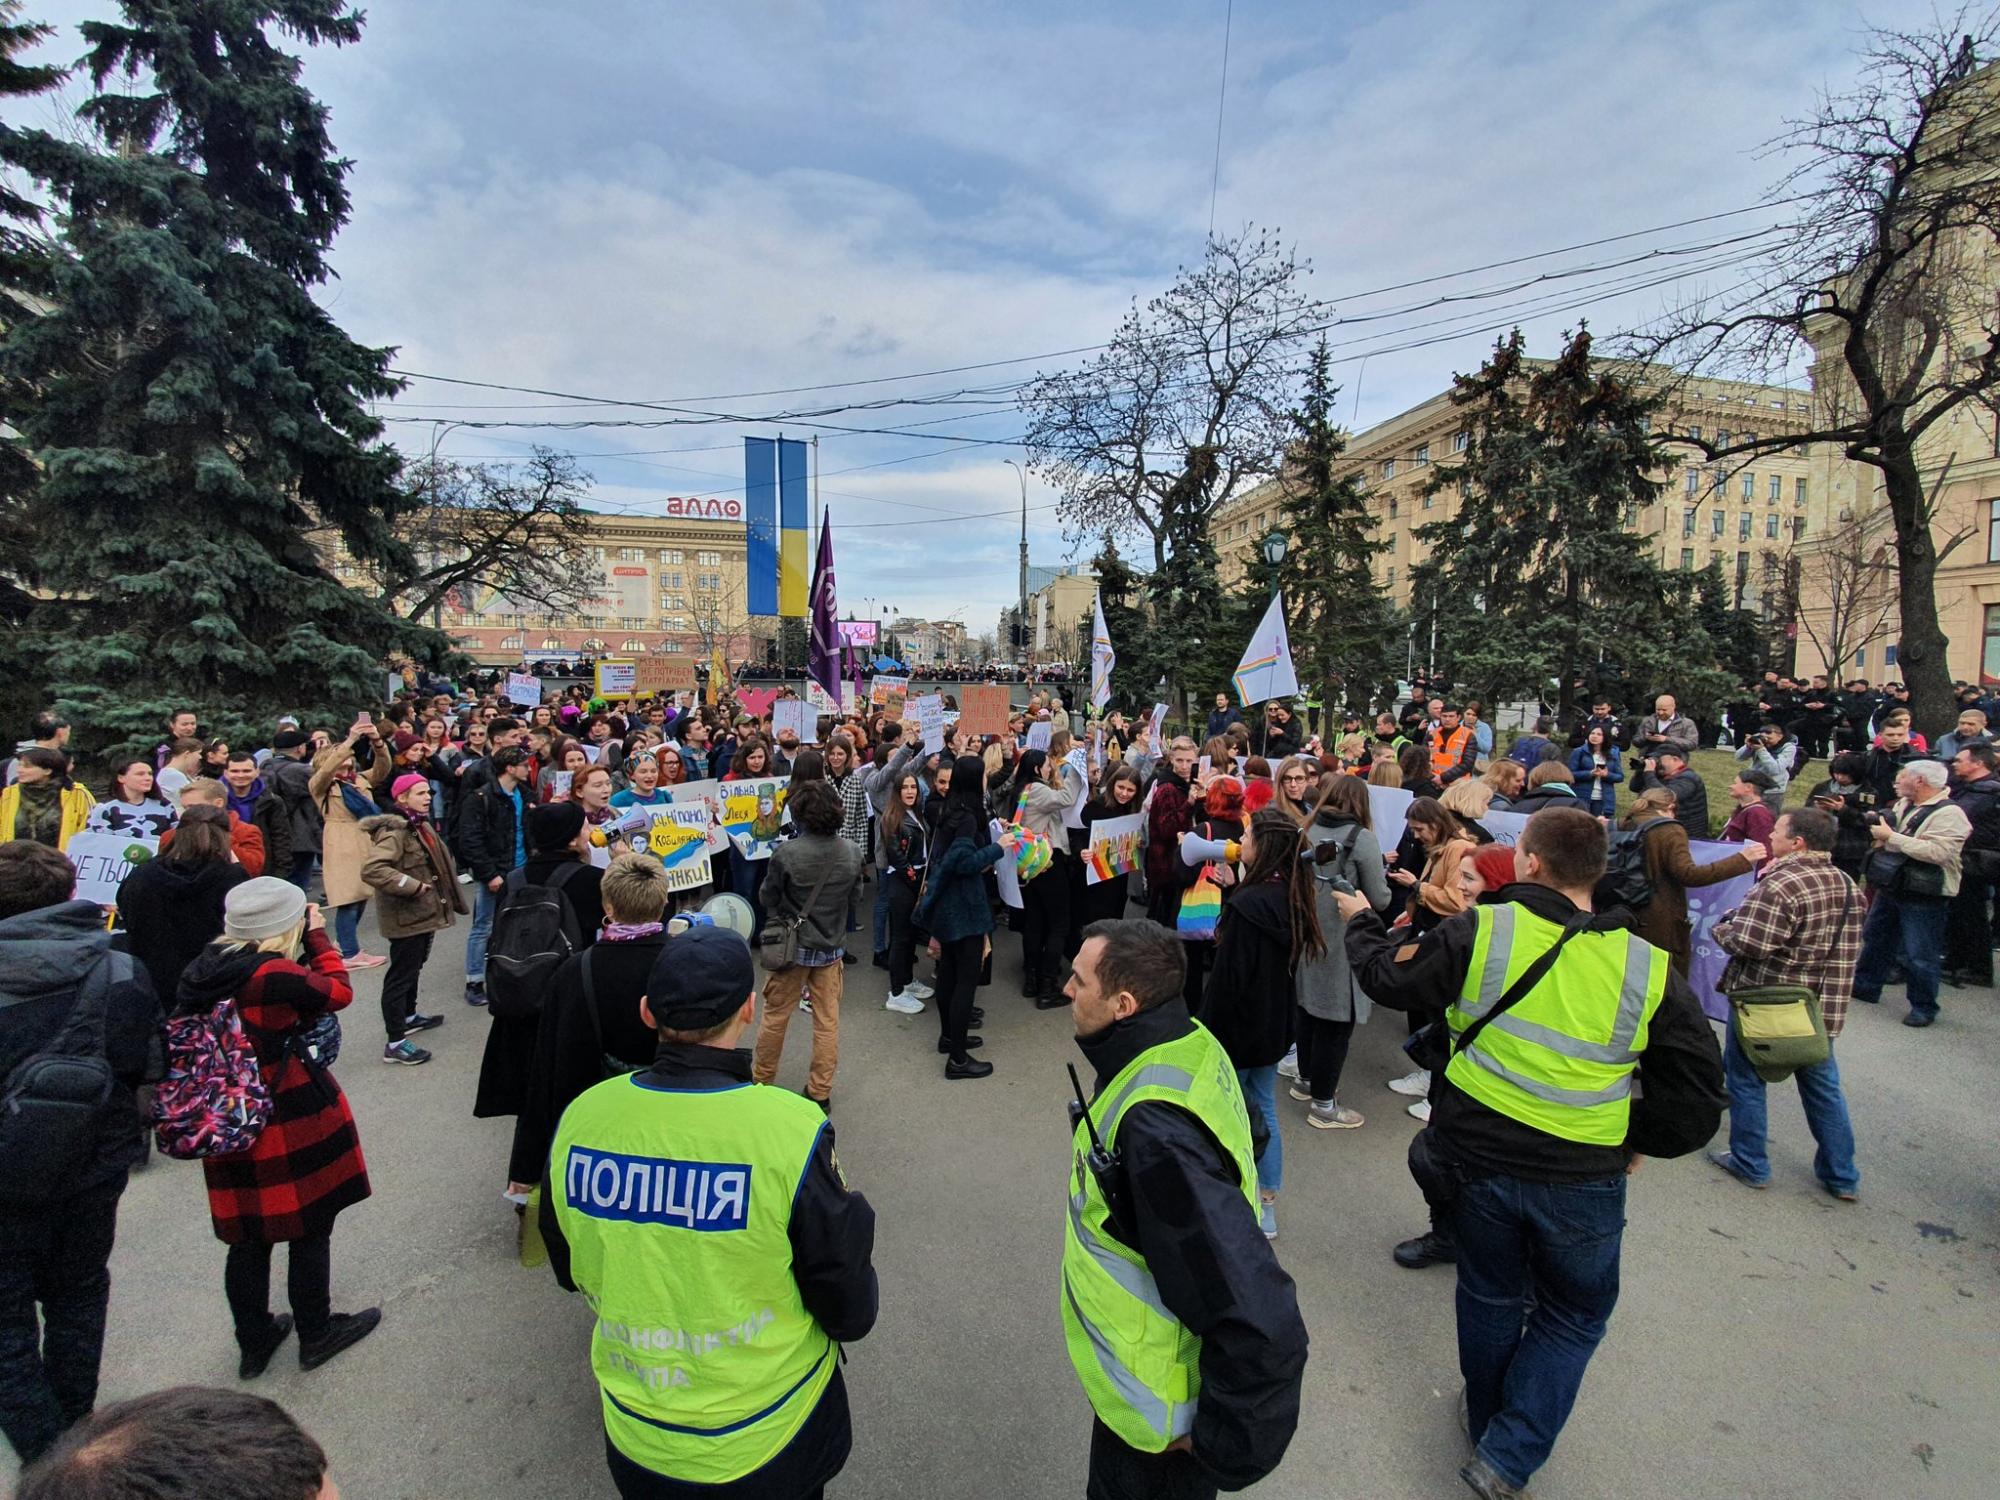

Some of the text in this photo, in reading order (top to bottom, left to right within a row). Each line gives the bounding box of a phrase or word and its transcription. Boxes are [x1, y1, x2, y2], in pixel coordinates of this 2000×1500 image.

[640, 658, 665, 666] МЕНІ
[641, 667, 693, 677] НЕ ПОТРІБЕН
[568, 1152, 746, 1228] ПОЛІЦІЯ
